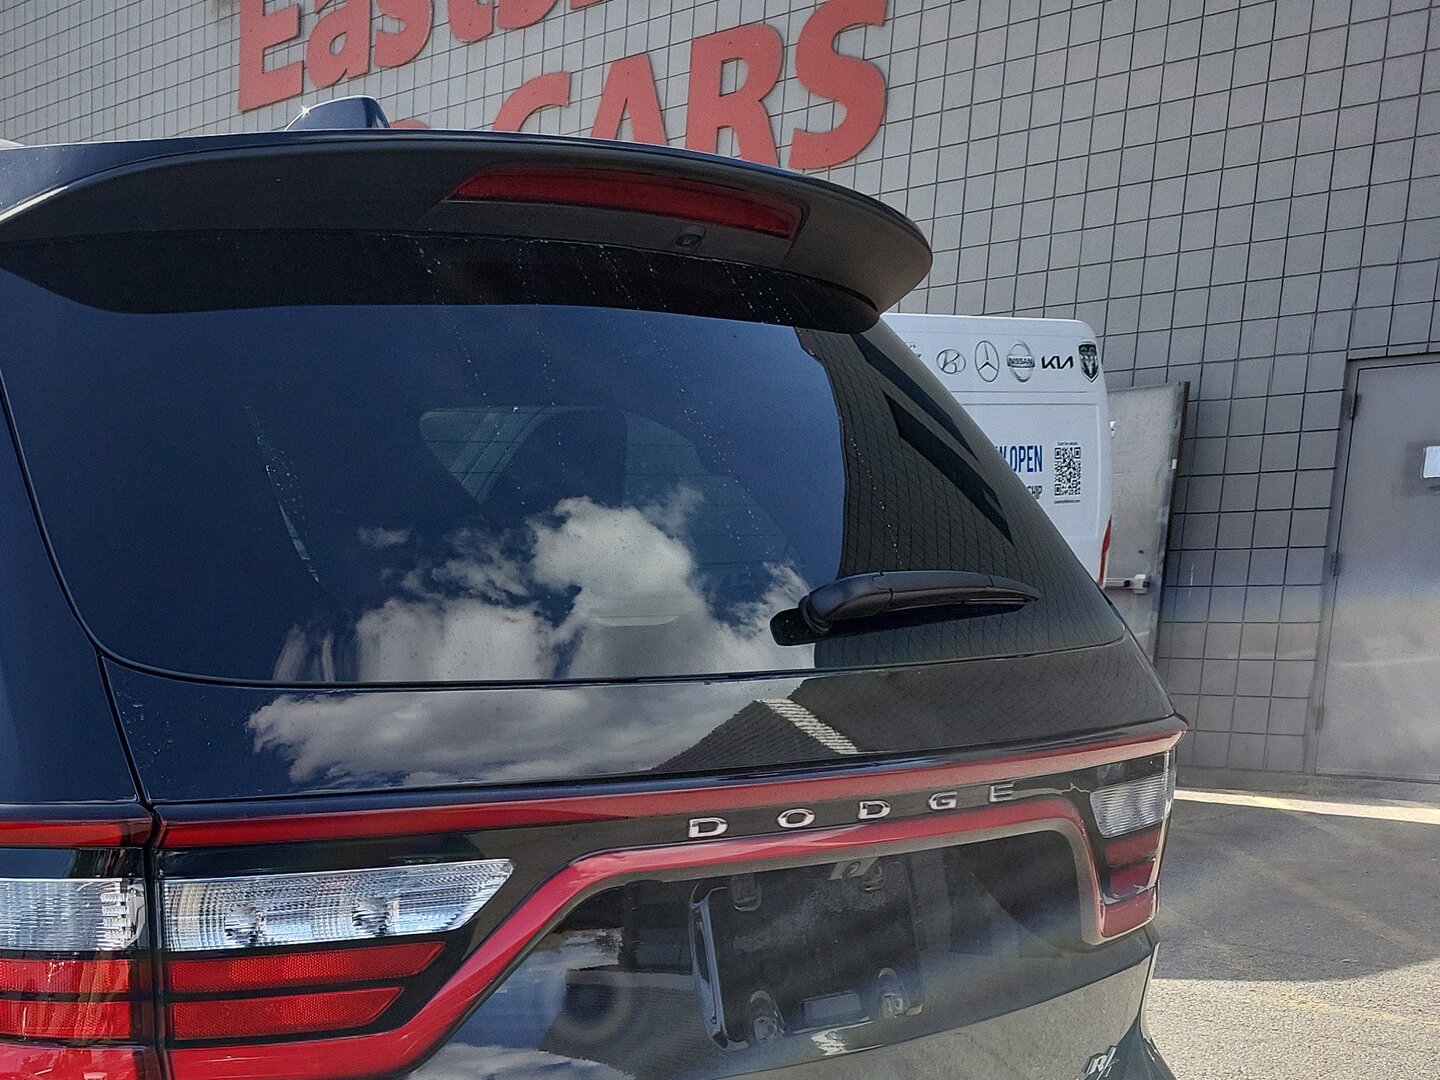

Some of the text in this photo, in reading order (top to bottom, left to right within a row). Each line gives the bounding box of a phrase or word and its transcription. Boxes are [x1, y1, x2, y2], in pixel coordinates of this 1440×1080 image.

[1041, 355, 1074, 369] KIA
[1010, 445, 1043, 473] OPEN
[688, 781, 1017, 839] DODGE
